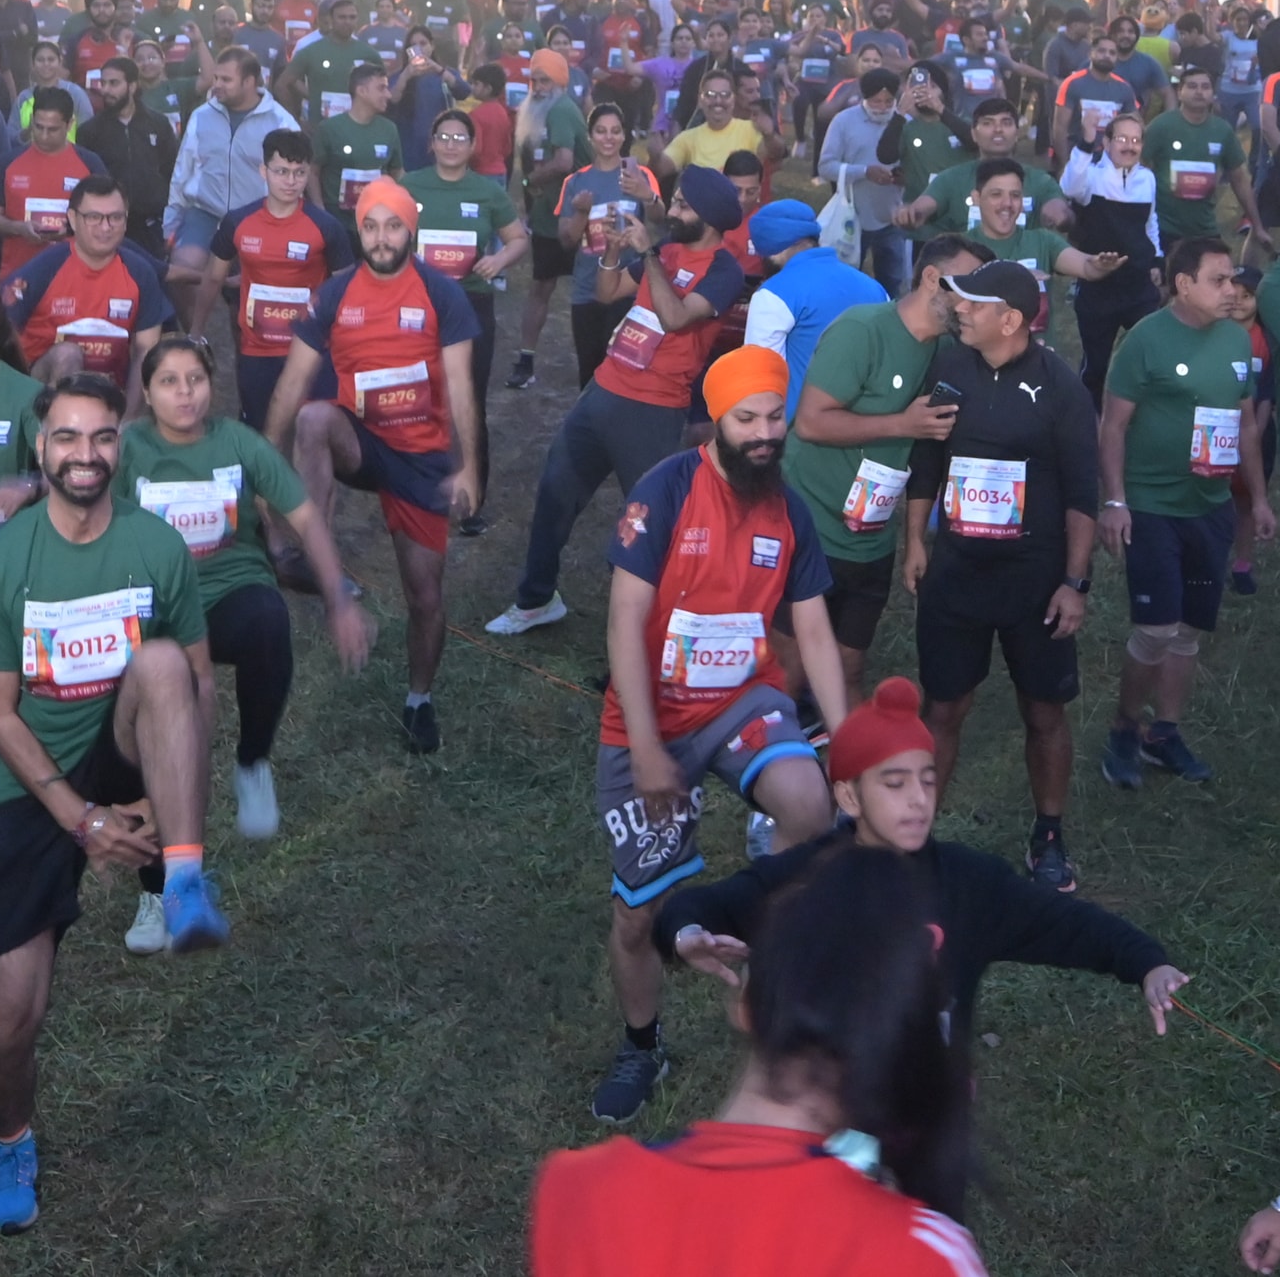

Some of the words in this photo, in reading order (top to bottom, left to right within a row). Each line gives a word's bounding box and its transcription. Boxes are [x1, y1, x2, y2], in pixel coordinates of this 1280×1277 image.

[433, 249, 465, 261] 5299
[262, 306, 298, 320] 5468
[377, 389, 417, 406] 5276
[961, 487, 1012, 505] 10034
[169, 511, 218, 527] 10113
[57, 634, 119, 660] 10112
[690, 650, 751, 667] 10227
[636, 823, 682, 868] 23
